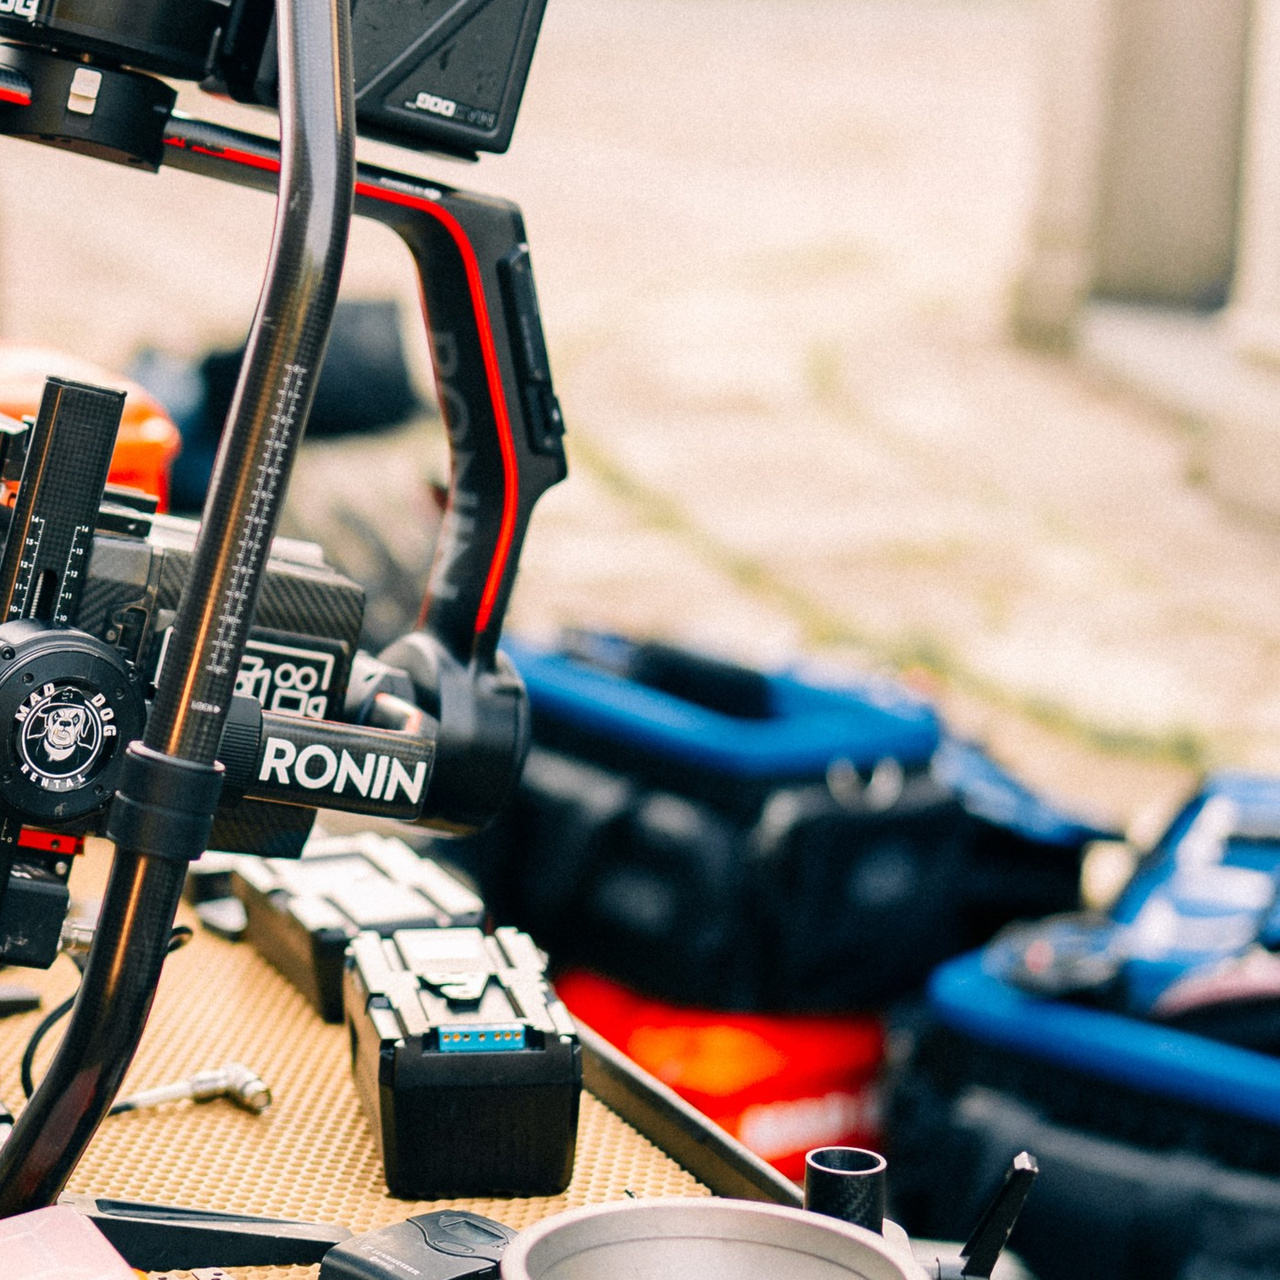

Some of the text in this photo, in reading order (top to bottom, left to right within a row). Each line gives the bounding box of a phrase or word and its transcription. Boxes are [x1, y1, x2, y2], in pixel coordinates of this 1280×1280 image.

[31, 515, 39, 523] 14
[15, 683, 117, 737] MAD DOG
[20, 763, 86, 789] RENTAL
[258, 736, 427, 805] RONIN
